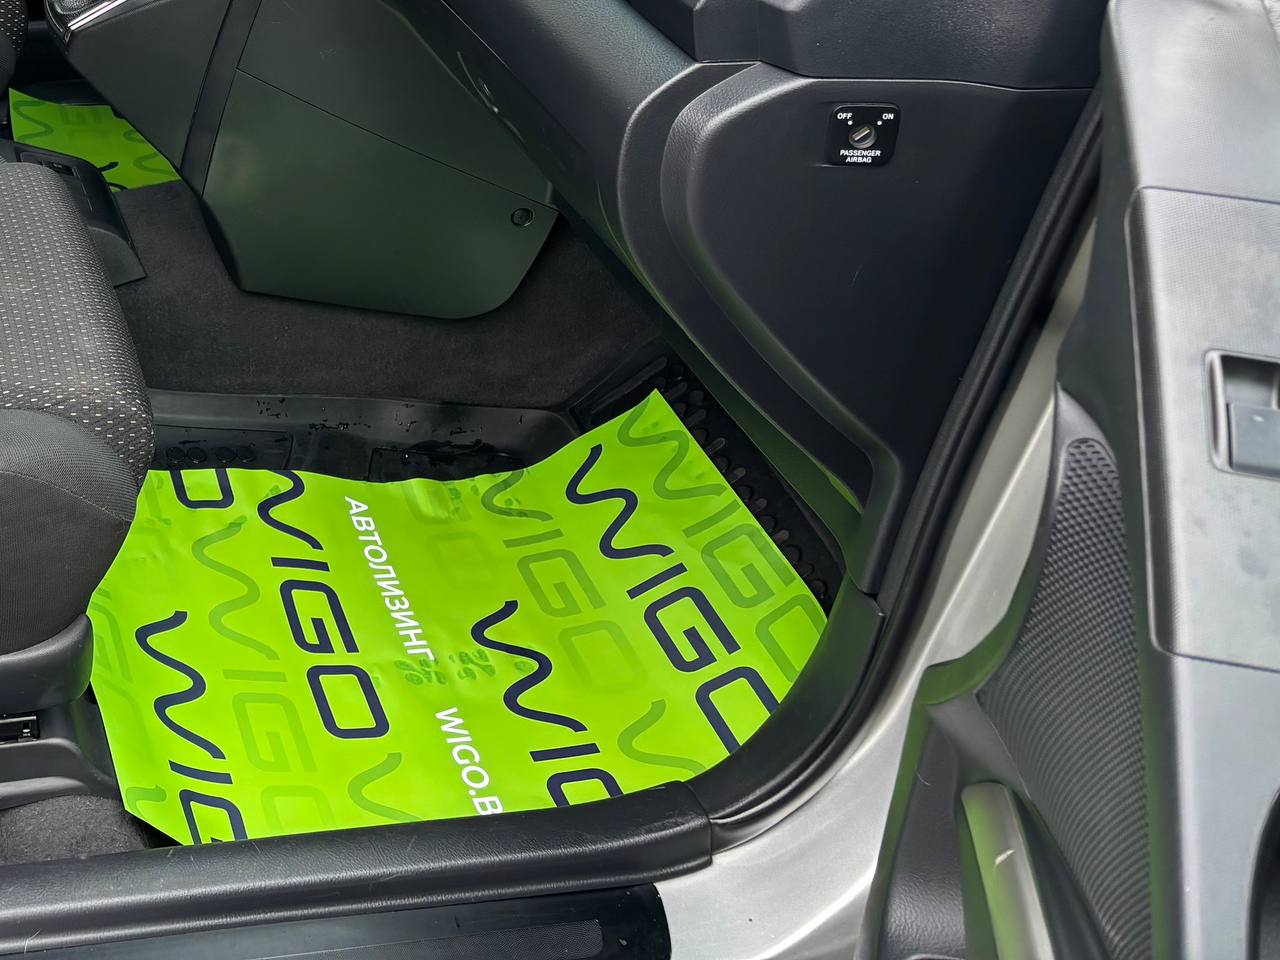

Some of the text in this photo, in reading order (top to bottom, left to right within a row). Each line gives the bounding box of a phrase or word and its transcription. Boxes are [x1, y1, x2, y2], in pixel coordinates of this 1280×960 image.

[837, 112, 853, 120] OFF
[839, 149, 881, 157] PASSENGER
[344, 496, 435, 662] АВТОЛИЗИНГ
[435, 706, 504, 816] WIGO.B
